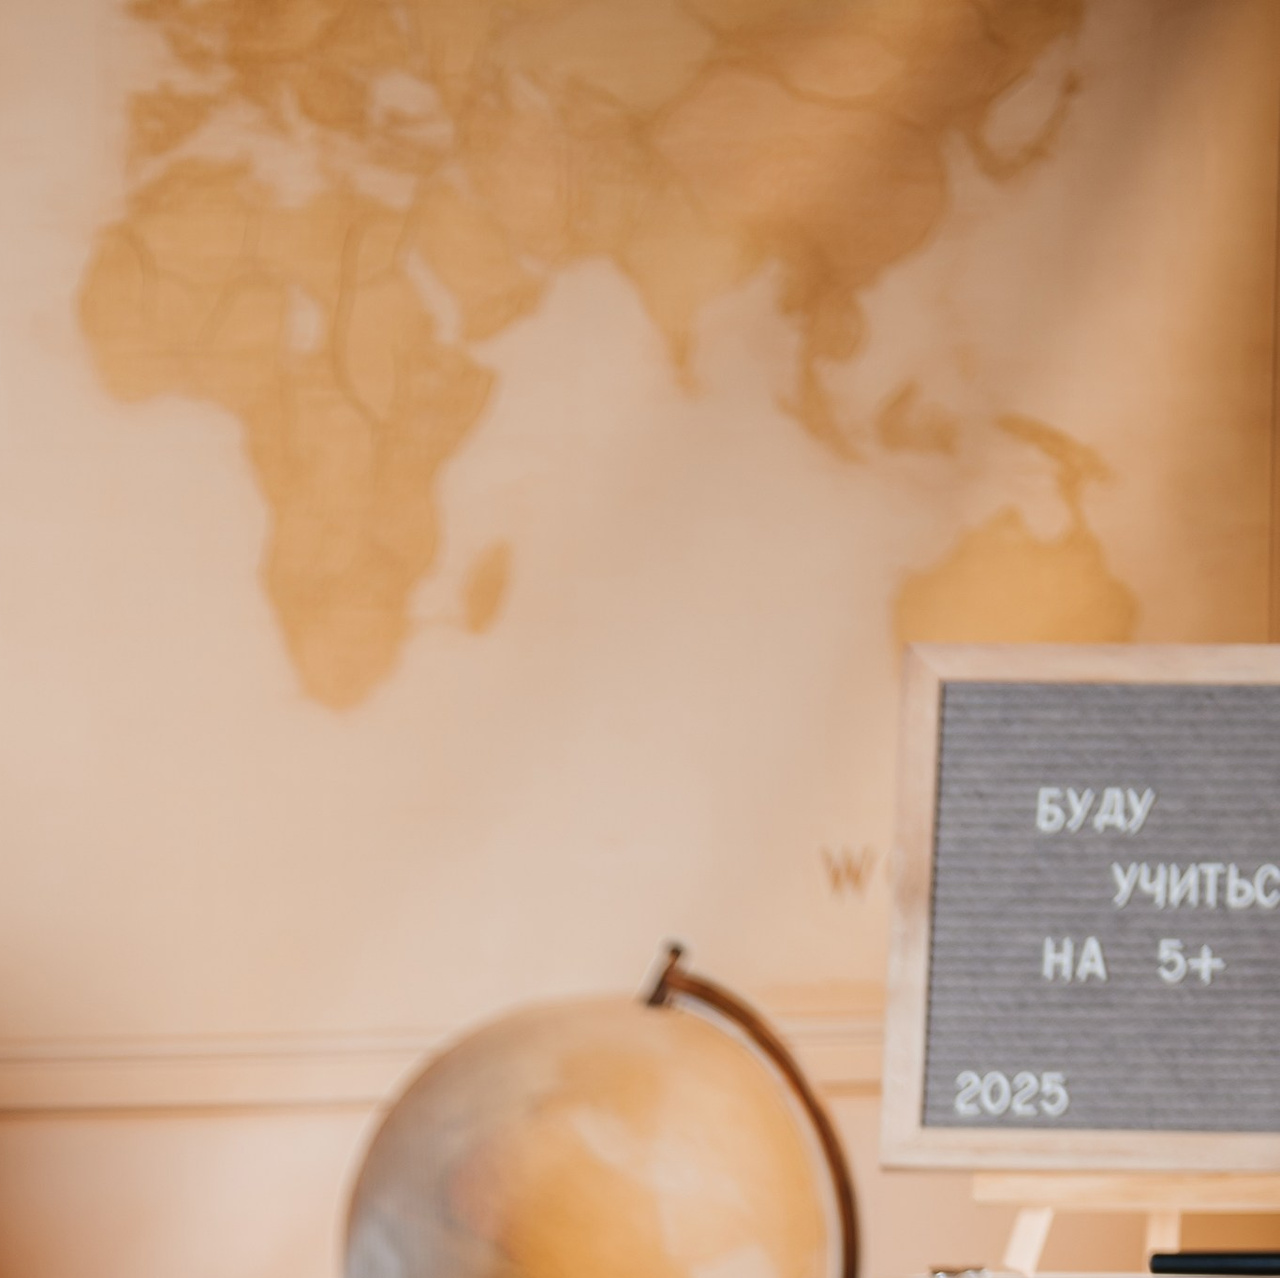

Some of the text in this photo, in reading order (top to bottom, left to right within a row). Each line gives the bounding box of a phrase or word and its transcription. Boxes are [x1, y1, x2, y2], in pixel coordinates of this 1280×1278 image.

[1035, 786, 1156, 834] БУДУ
[1041, 936, 1225, 985] НА 5+
[954, 1070, 1070, 1117] 2025
